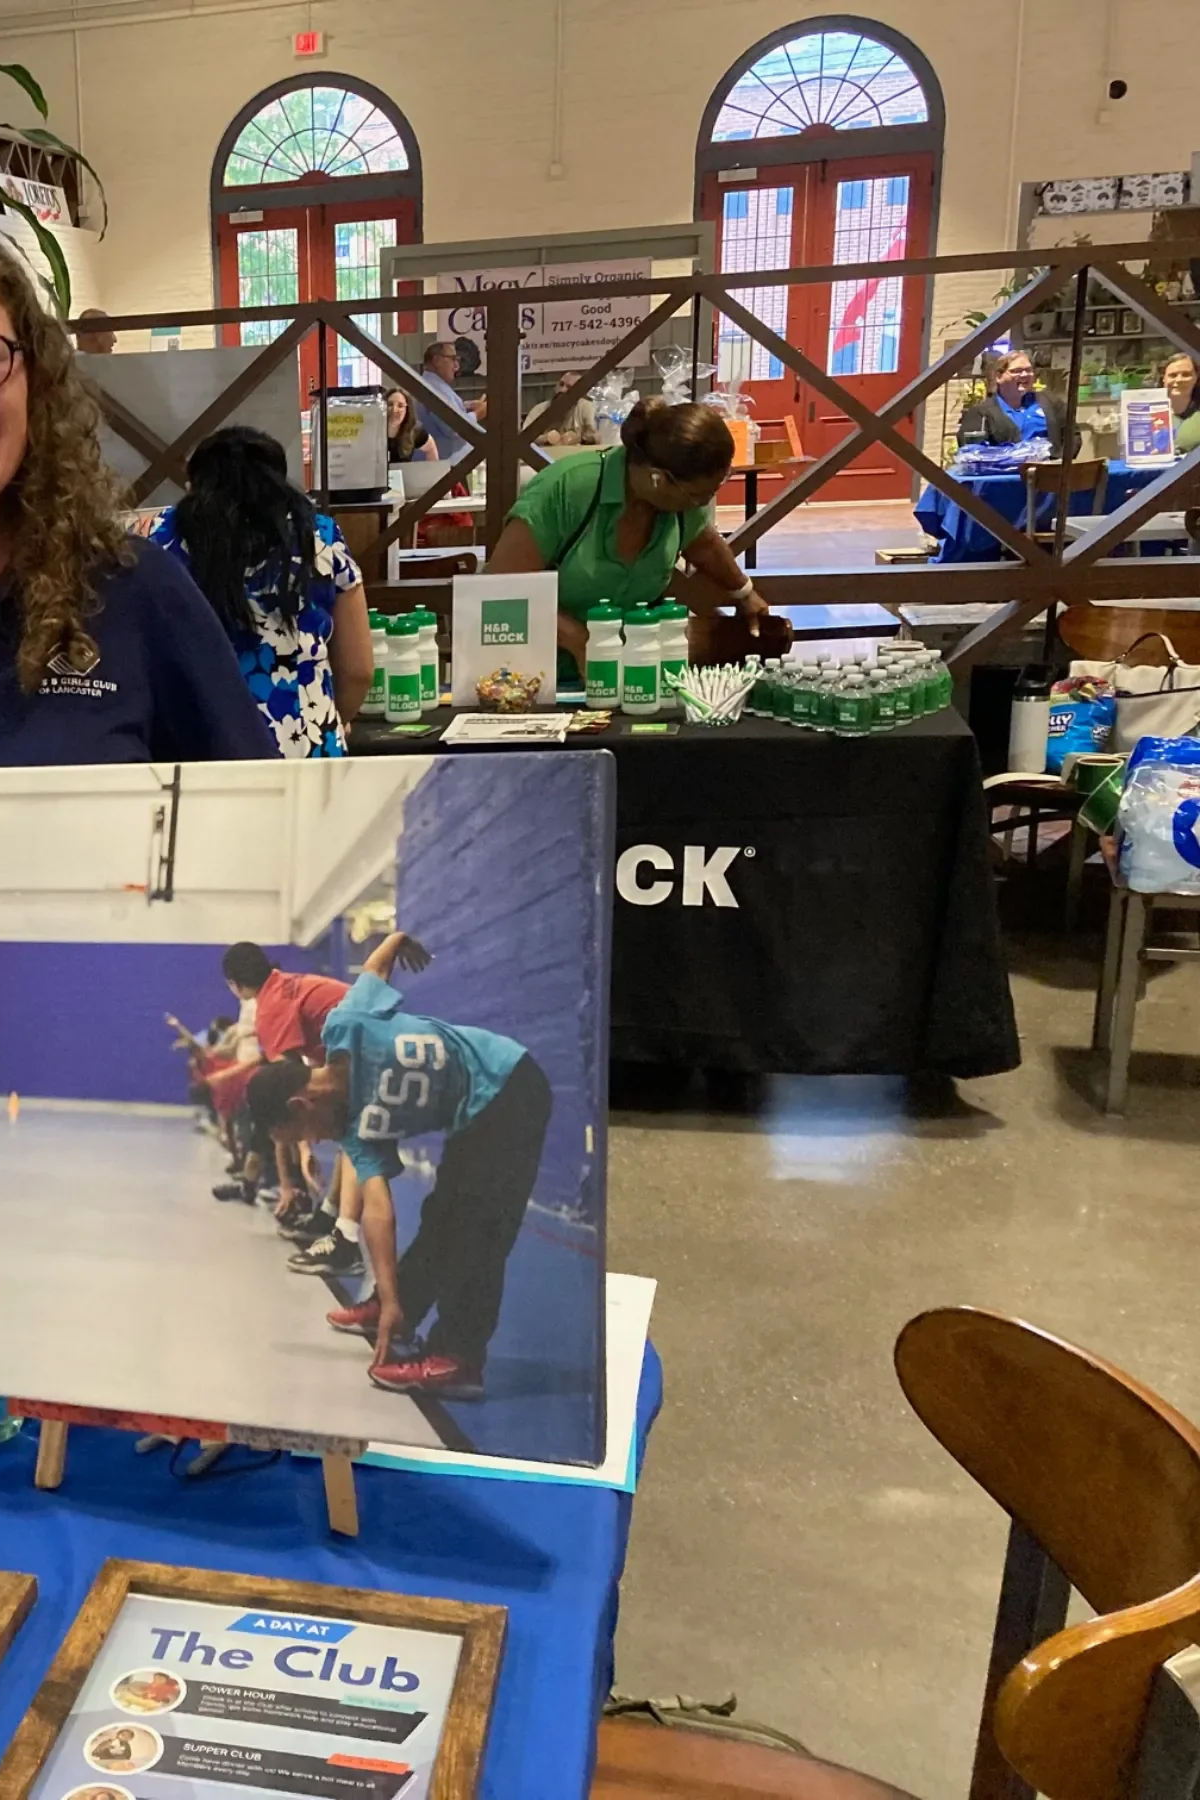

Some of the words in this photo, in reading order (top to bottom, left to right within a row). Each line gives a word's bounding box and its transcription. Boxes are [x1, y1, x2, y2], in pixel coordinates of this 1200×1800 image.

[581, 303, 612, 315] Good
[448, 306, 536, 335] Cas
[551, 316, 641, 332] 717-542-4396
[483, 623, 510, 633] H&R
[483, 633, 525, 643] BLOCK
[60, 677, 91, 687] GIRLS
[93, 679, 118, 692] CLUB
[52, 687, 102, 697] LANCASTER
[587, 688, 616, 696] BLOCK
[625, 693, 655, 701] BLOCK
[390, 702, 419, 710] BLOCK
[1049, 713, 1072, 725] LLY
[253, 1618, 266, 1629] A
[270, 1619, 302, 1632] DAY
[305, 1623, 330, 1637] AT
[151, 1628, 254, 1670] The
[273, 1645, 420, 1693] Club
[201, 1684, 241, 1697] POWER
[243, 1690, 276, 1701] HOUR
[183, 1743, 228, 1756] SUPPER
[230, 1750, 262, 1761] CLUB
[278, 1768, 290, 1776] We
